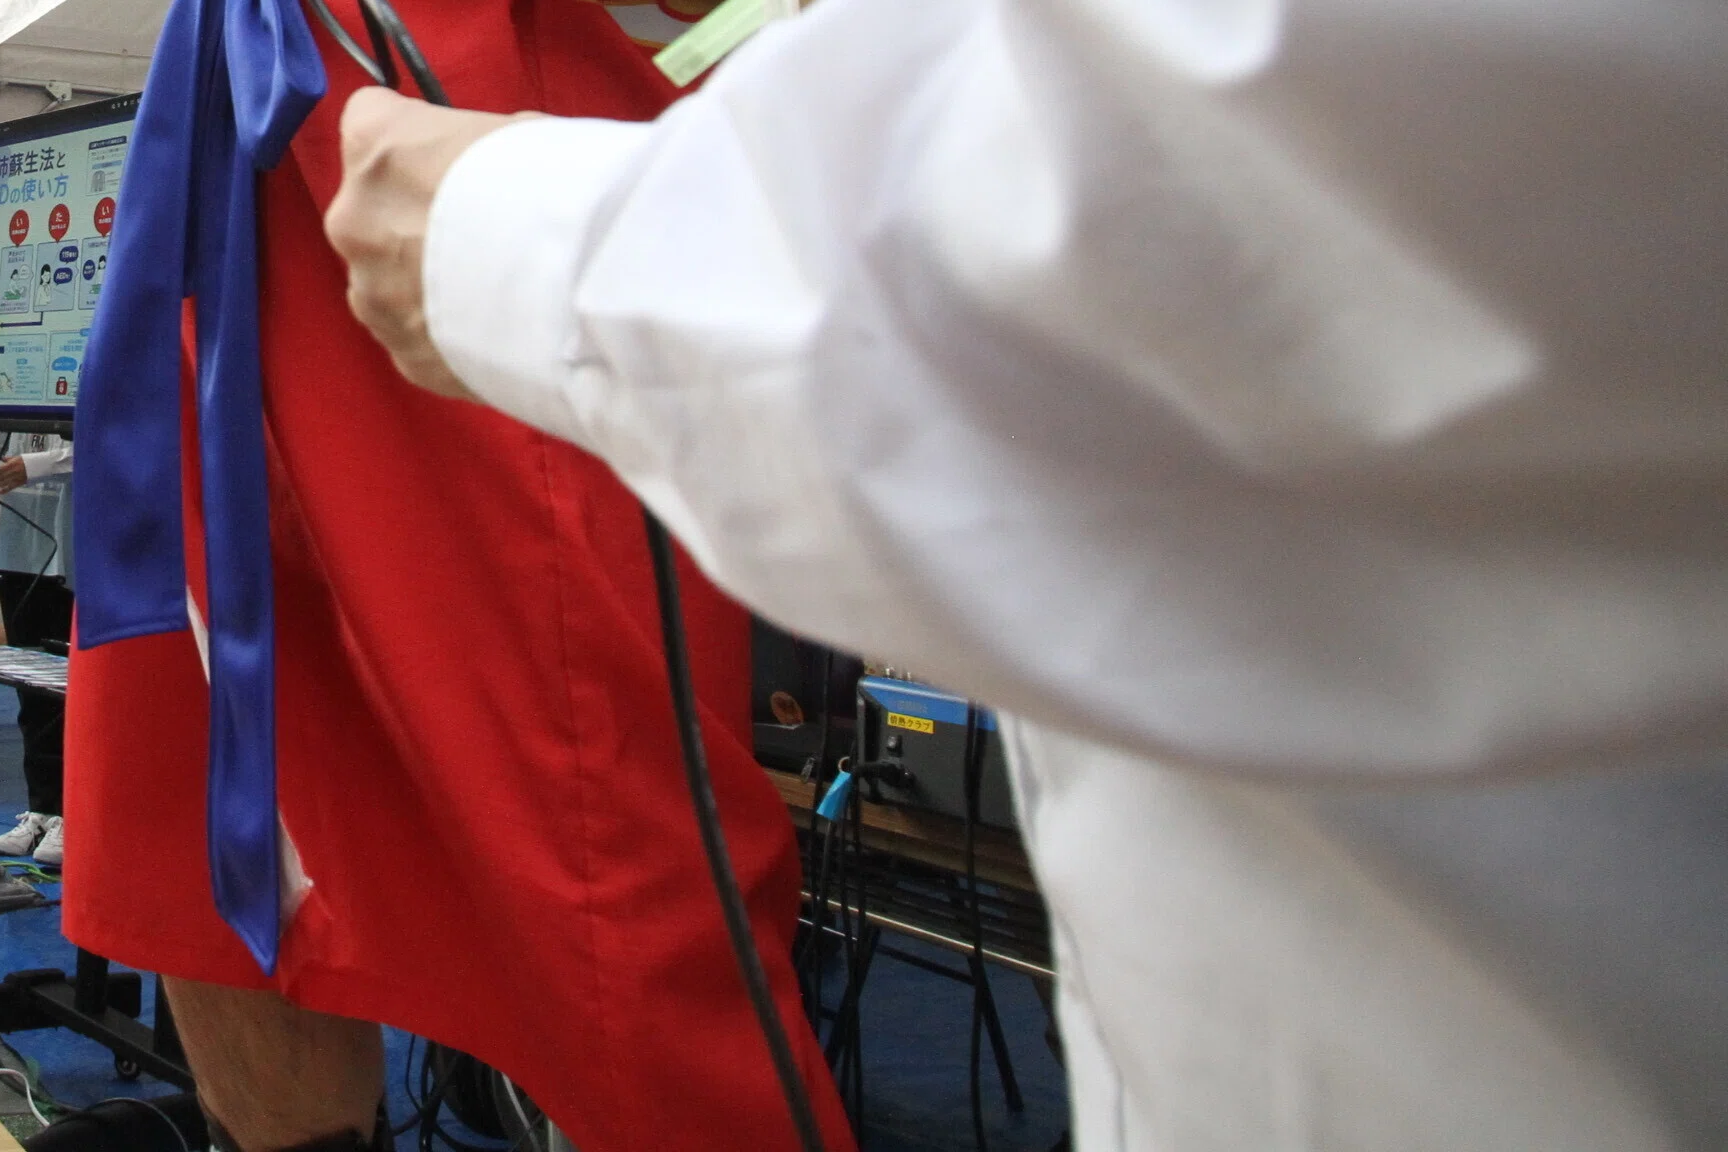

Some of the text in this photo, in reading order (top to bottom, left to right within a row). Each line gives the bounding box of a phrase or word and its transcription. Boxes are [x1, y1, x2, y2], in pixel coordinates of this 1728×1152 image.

[889, 714, 932, 732] 情熱クラブ
